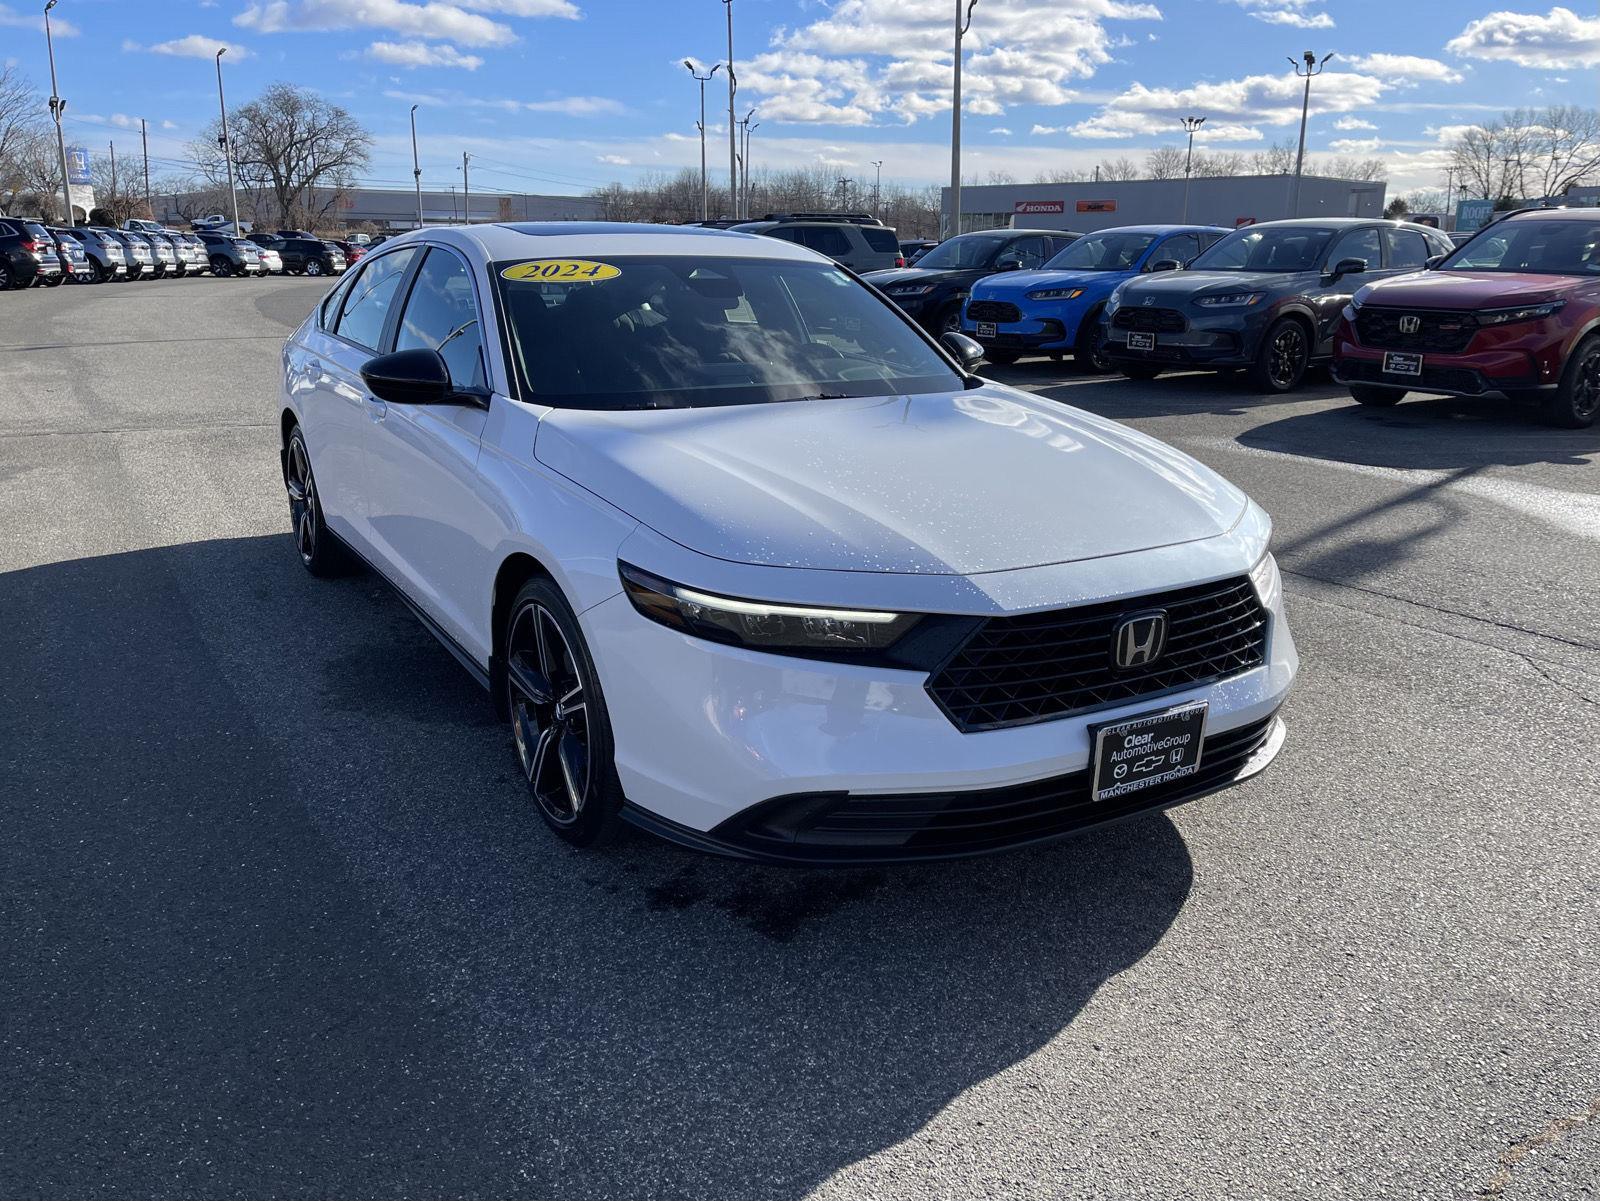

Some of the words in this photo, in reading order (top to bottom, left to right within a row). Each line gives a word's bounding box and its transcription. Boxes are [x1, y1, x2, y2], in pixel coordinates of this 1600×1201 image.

[521, 264, 602, 278] 2024
[1107, 723, 1131, 735] CLEAR
[1132, 714, 1178, 729] AUTOMOTIVE
[1110, 733, 1191, 763] AutomotiveGroup
[1124, 732, 1154, 748] Clear
[1100, 776, 1161, 799] MANCHESTER
[1163, 767, 1193, 782] HONDA
